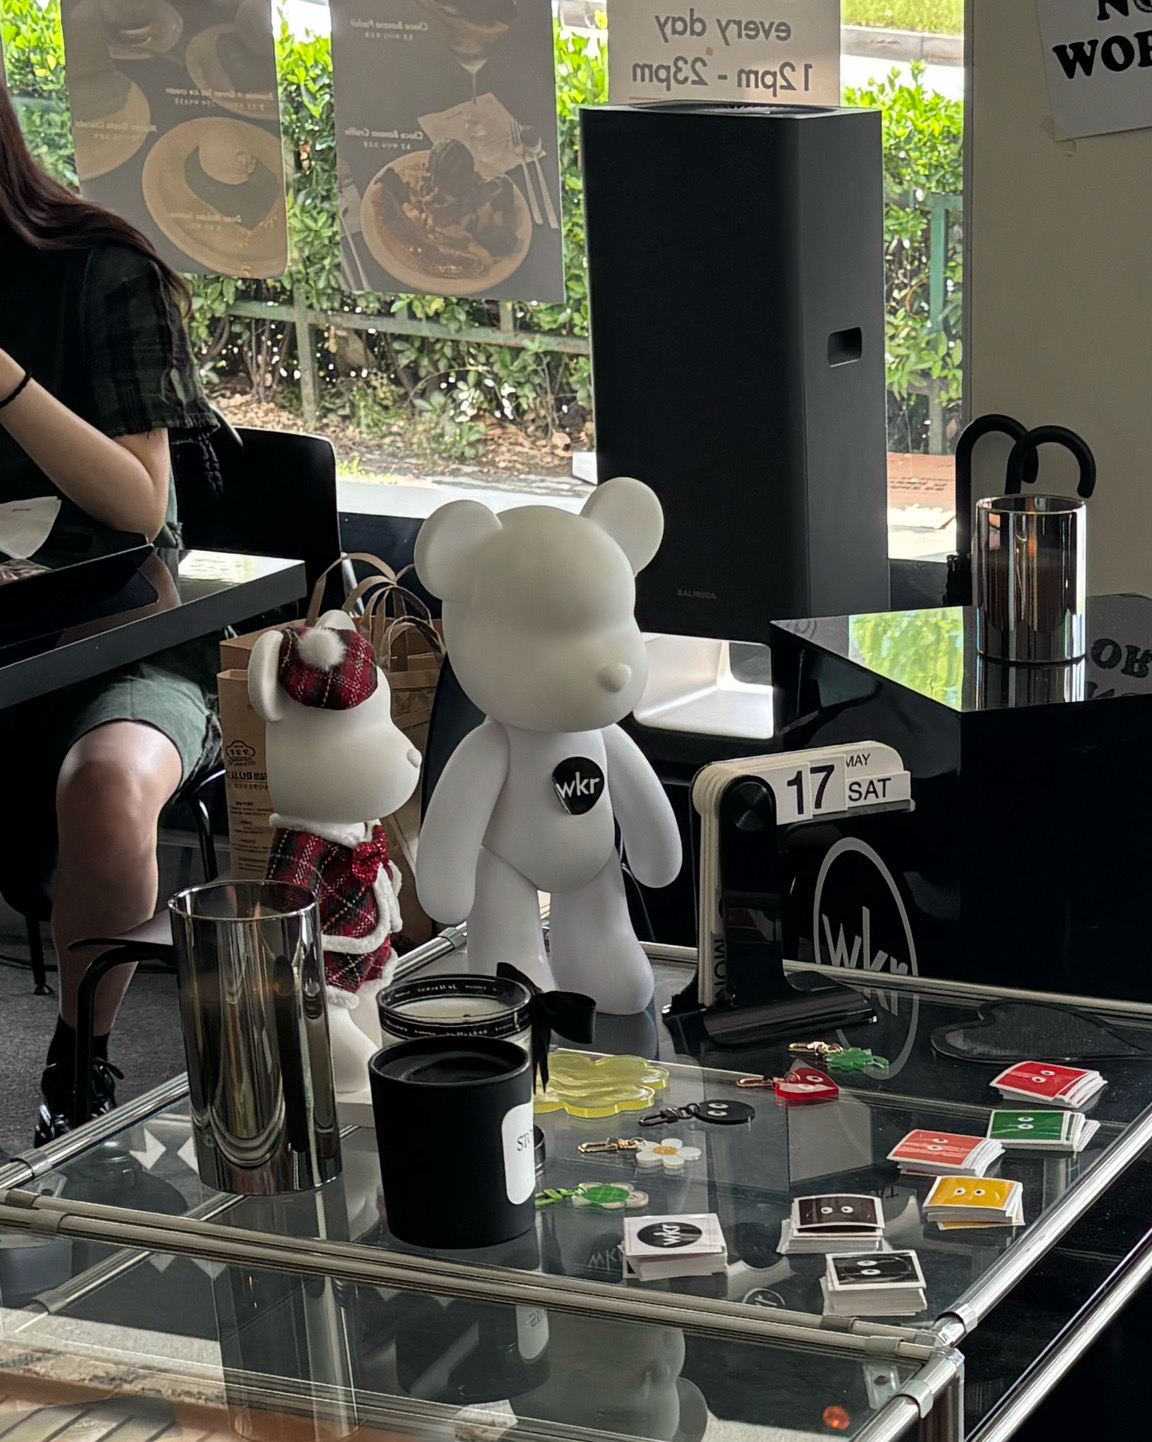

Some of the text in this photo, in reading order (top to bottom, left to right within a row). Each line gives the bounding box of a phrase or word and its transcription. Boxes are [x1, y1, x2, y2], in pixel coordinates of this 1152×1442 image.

[556, 771, 600, 799] wkr
[786, 764, 836, 815] 17
[848, 777, 892, 801] SAT
[653, 1222, 681, 1246] wkr
